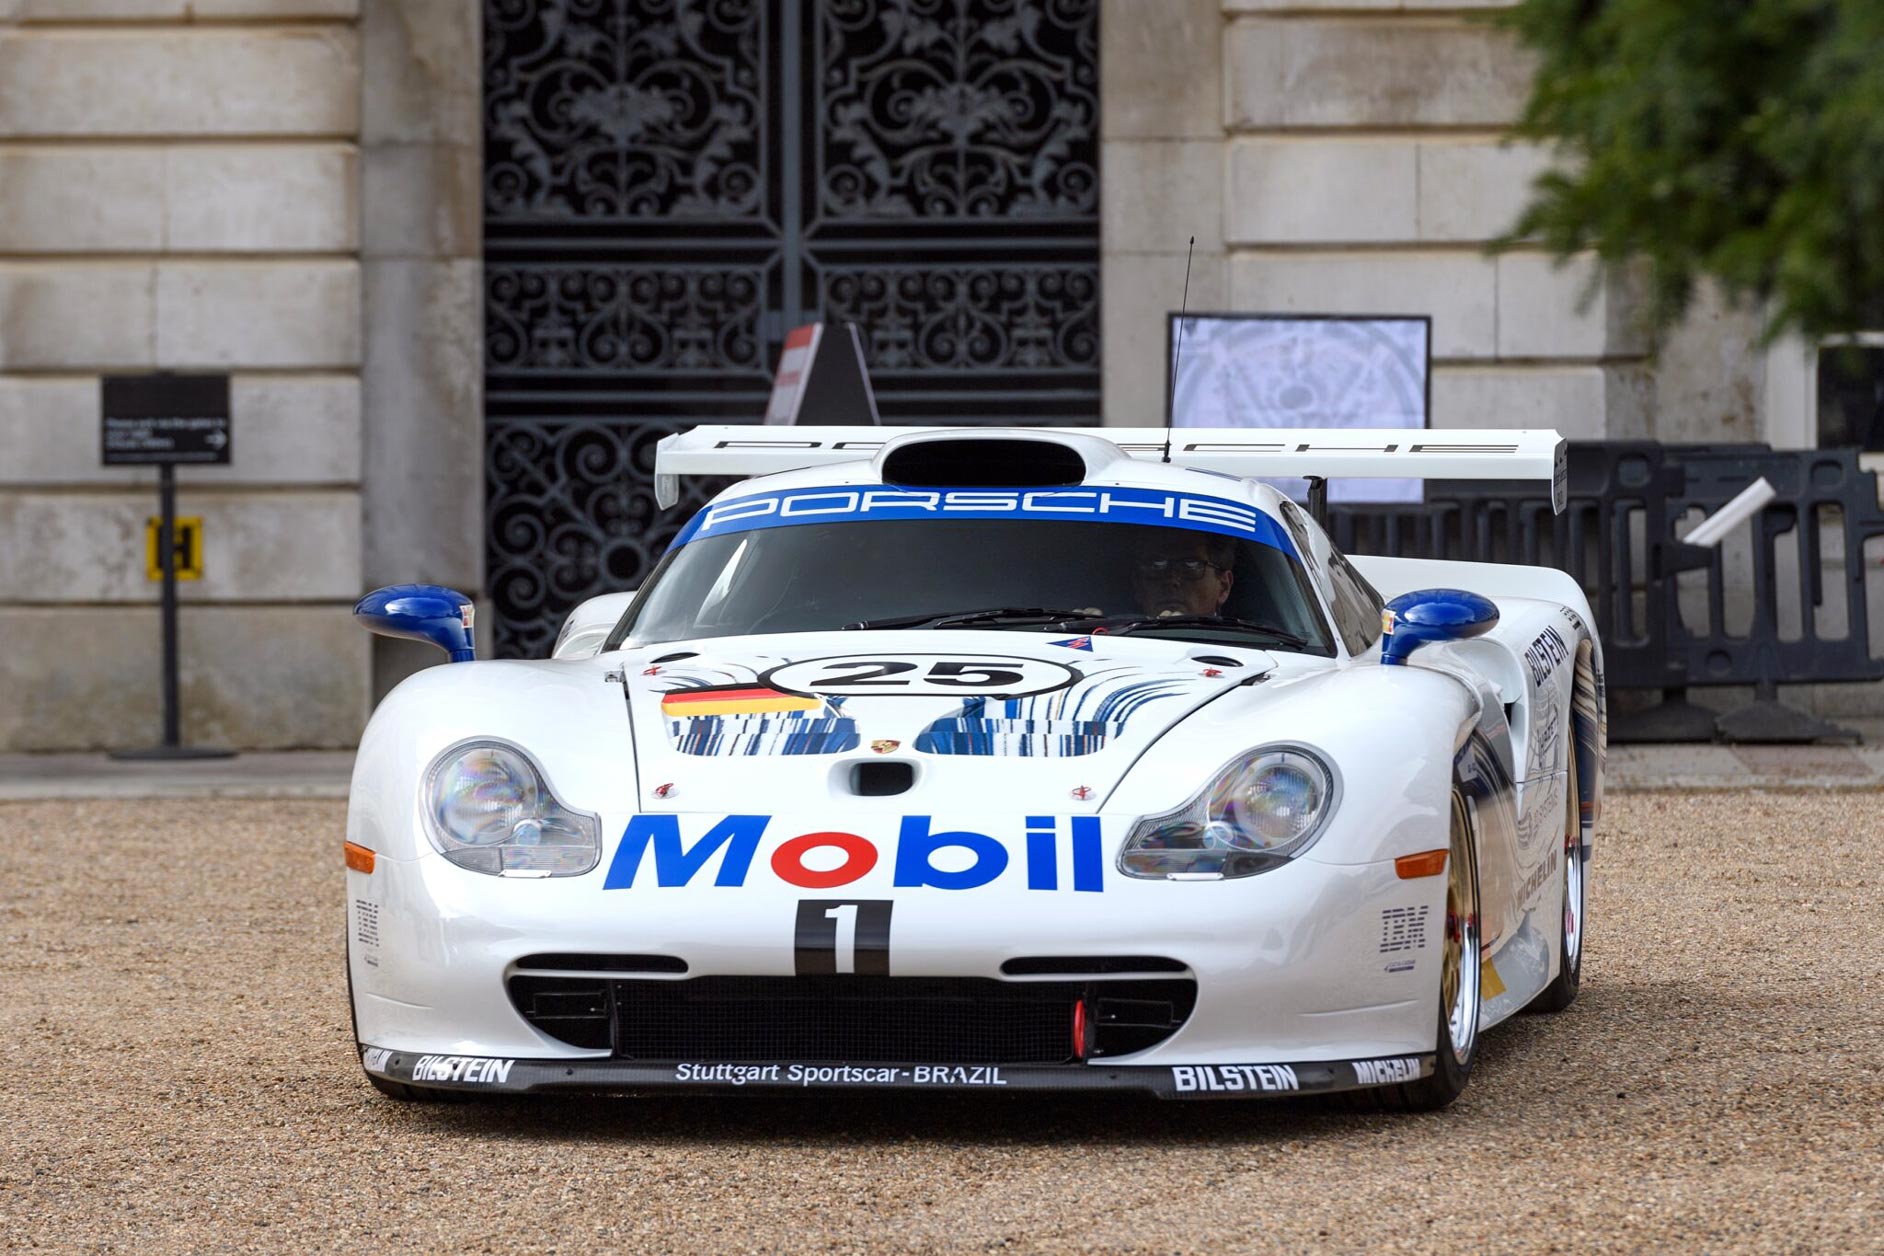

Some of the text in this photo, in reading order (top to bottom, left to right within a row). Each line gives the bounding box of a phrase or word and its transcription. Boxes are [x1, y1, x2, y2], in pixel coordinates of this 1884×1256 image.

[702, 491, 1256, 533] PORSCHE
[810, 661, 1024, 687] 25
[1524, 625, 1569, 688] BILSTEIN
[602, 815, 1104, 893] Mobil
[824, 904, 858, 974] 1
[1380, 905, 1428, 953] IBM
[412, 1055, 515, 1083] BILSTEIN
[675, 1063, 780, 1085] Stuttgart
[1172, 1065, 1299, 1091] BILSTEIN
[1352, 1058, 1421, 1084] MICHELIN
